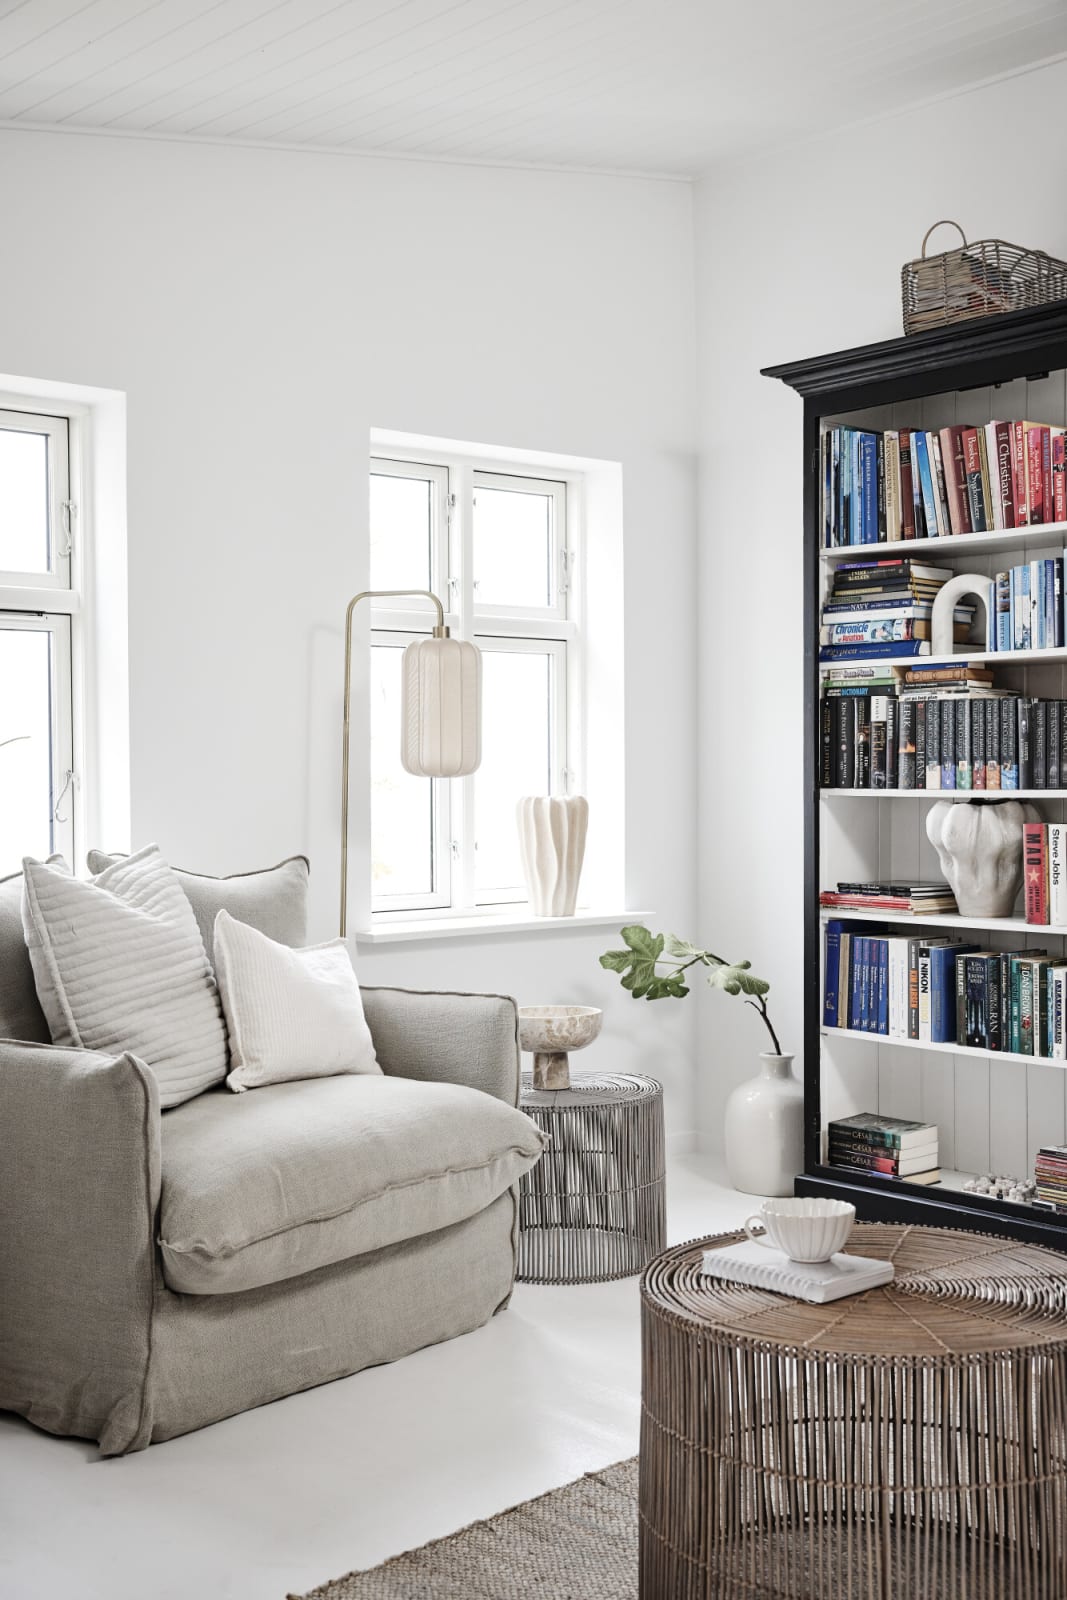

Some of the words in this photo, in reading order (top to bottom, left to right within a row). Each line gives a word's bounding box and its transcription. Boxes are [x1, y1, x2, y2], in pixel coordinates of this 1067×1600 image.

[1000, 443, 1010, 496] Christian
[850, 603, 869, 612] NAVY
[836, 623, 869, 635] Chronicle
[841, 687, 868, 696] DICTIONARY
[1026, 833, 1041, 866] MAO
[1052, 828, 1060, 858] Steve
[1052, 860, 1061, 885] Jobs
[920, 963, 928, 994] NIKON
[1021, 970, 1030, 988] DAN
[1021, 989, 1030, 1021] BROWN
[989, 1012, 998, 1033] RAN
